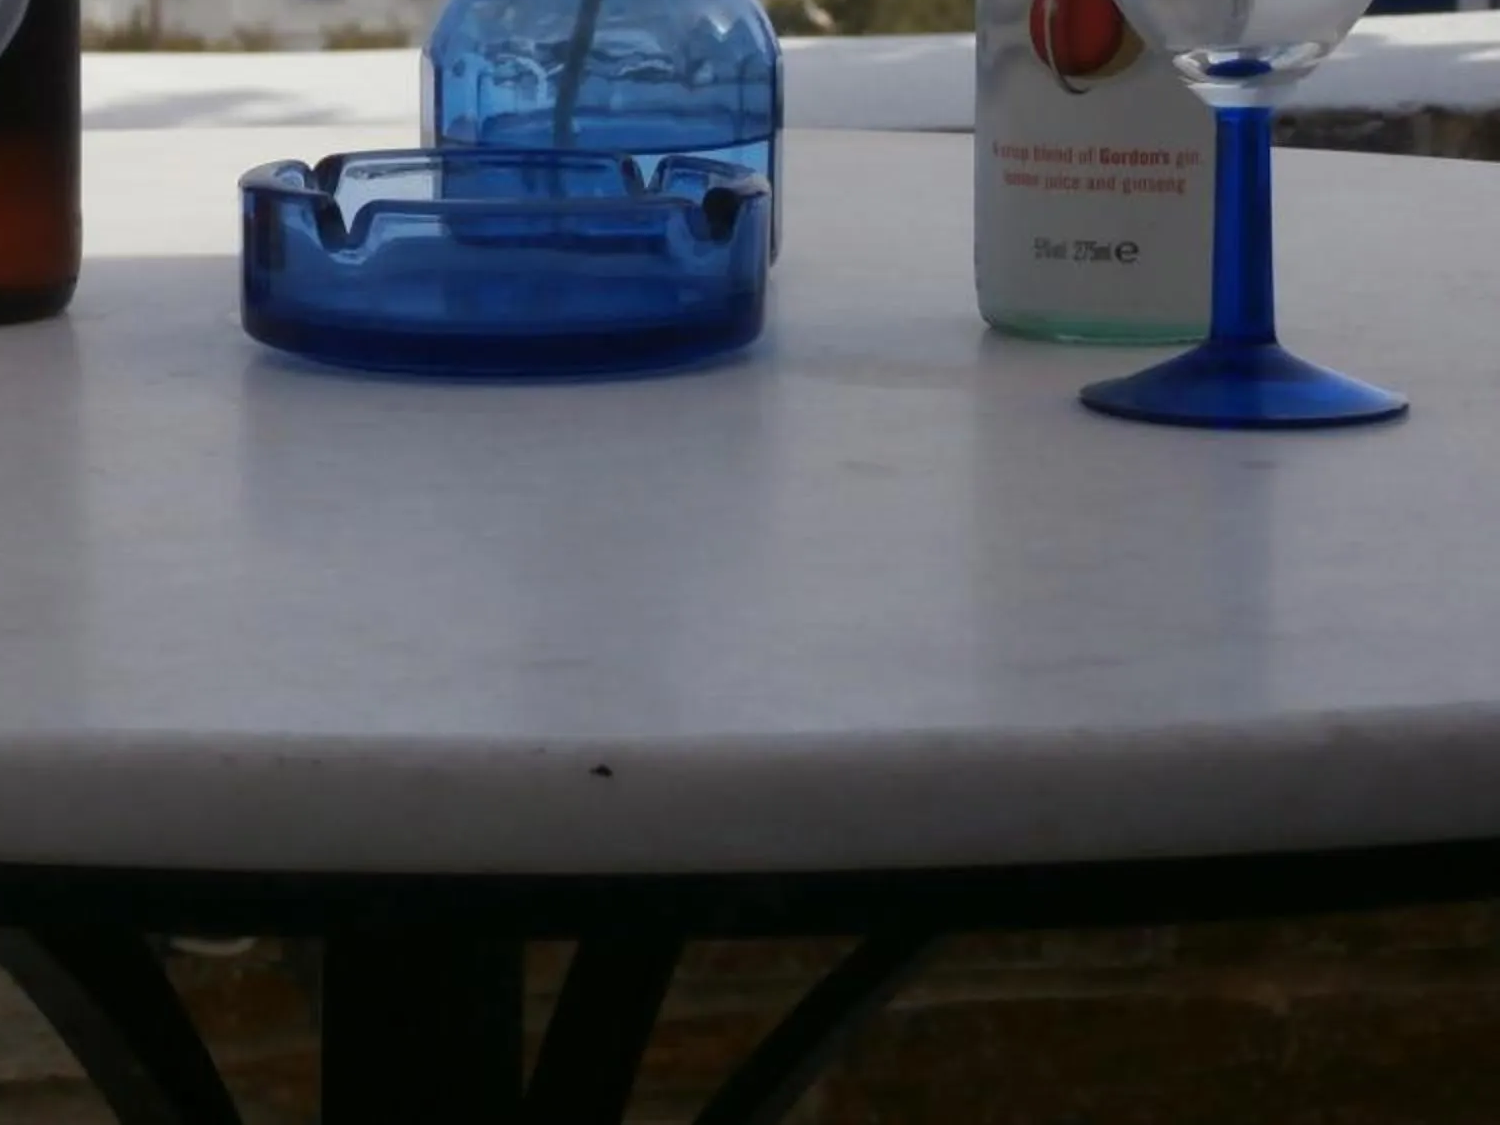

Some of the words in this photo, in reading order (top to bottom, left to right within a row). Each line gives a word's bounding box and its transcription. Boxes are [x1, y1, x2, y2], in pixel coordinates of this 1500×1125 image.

[1099, 146, 1170, 166] Gordon's
[1086, 176, 1116, 191] and
[1122, 176, 1186, 195] ginseng
